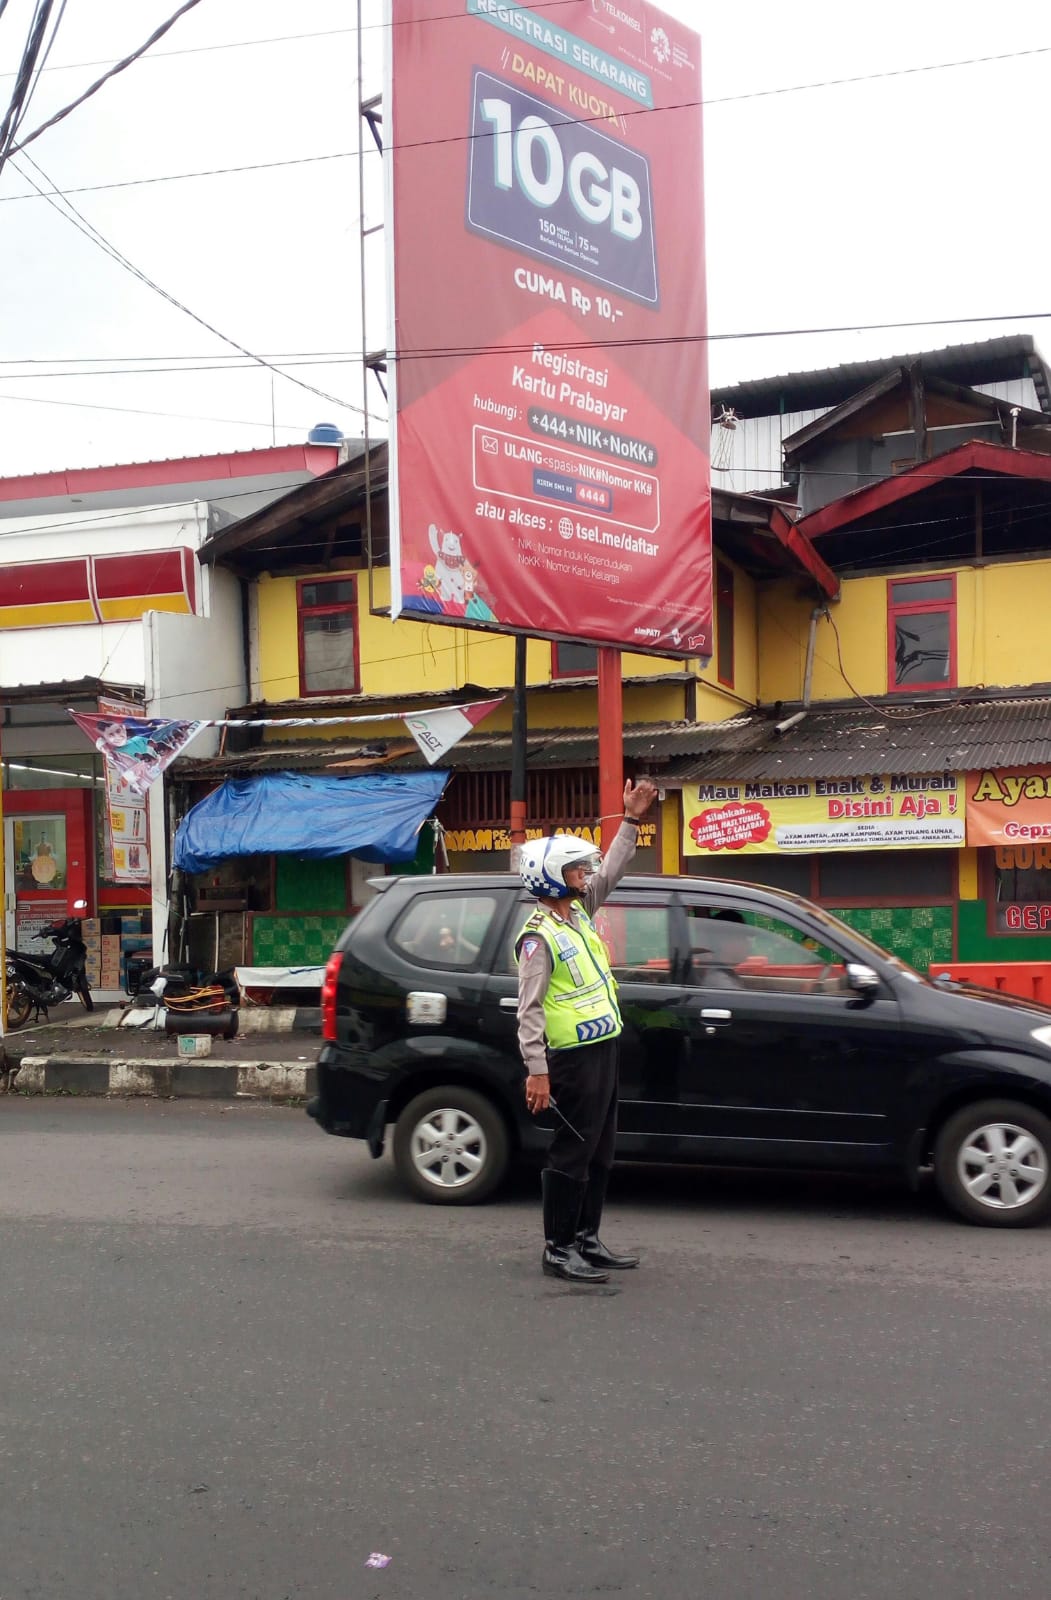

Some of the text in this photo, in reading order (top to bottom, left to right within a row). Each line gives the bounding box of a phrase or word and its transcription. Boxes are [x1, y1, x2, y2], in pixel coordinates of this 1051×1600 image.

[605, 1, 642, 33] TELKOMSEL
[476, 0, 568, 55] REGISTRASI
[572, 45, 647, 98] SEKARANG
[511, 53, 620, 128] DAPAT KUOTA
[539, 219, 556, 236] 150
[578, 236, 590, 251] 75
[513, 267, 624, 323] CUMA Rp 10,-
[531, 343, 609, 389] Registrasi
[472, 394, 518, 420] hubungi
[511, 366, 628, 423] Kartu Prabayar
[578, 488, 606, 504] 4444
[475, 502, 505, 522] atau
[508, 510, 547, 531] akses
[576, 523, 659, 558] tsel.me/daftar
[518, 538, 533, 550] NIK
[538, 543, 562, 557] Nomor
[563, 548, 583, 561] Induk
[583, 552, 633, 572] Kependudukan
[518, 554, 540, 567] NoKK
[546, 559, 571, 573] Nomor
[571, 565, 591, 577] Kartu
[591, 569, 620, 585] Keluarga
[421, 731, 444, 749] ACT
[698, 773, 957, 801] Mau Makan Enak & Murah
[973, 771, 1051, 806] Aya
[827, 795, 893, 820] Disini
[900, 794, 942, 819] Aja
[444, 829, 493, 851] AYAM
[697, 824, 720, 835] AMBIL
[698, 831, 725, 843] SAMBAL
[713, 831, 753, 847] SEPUASNYA
